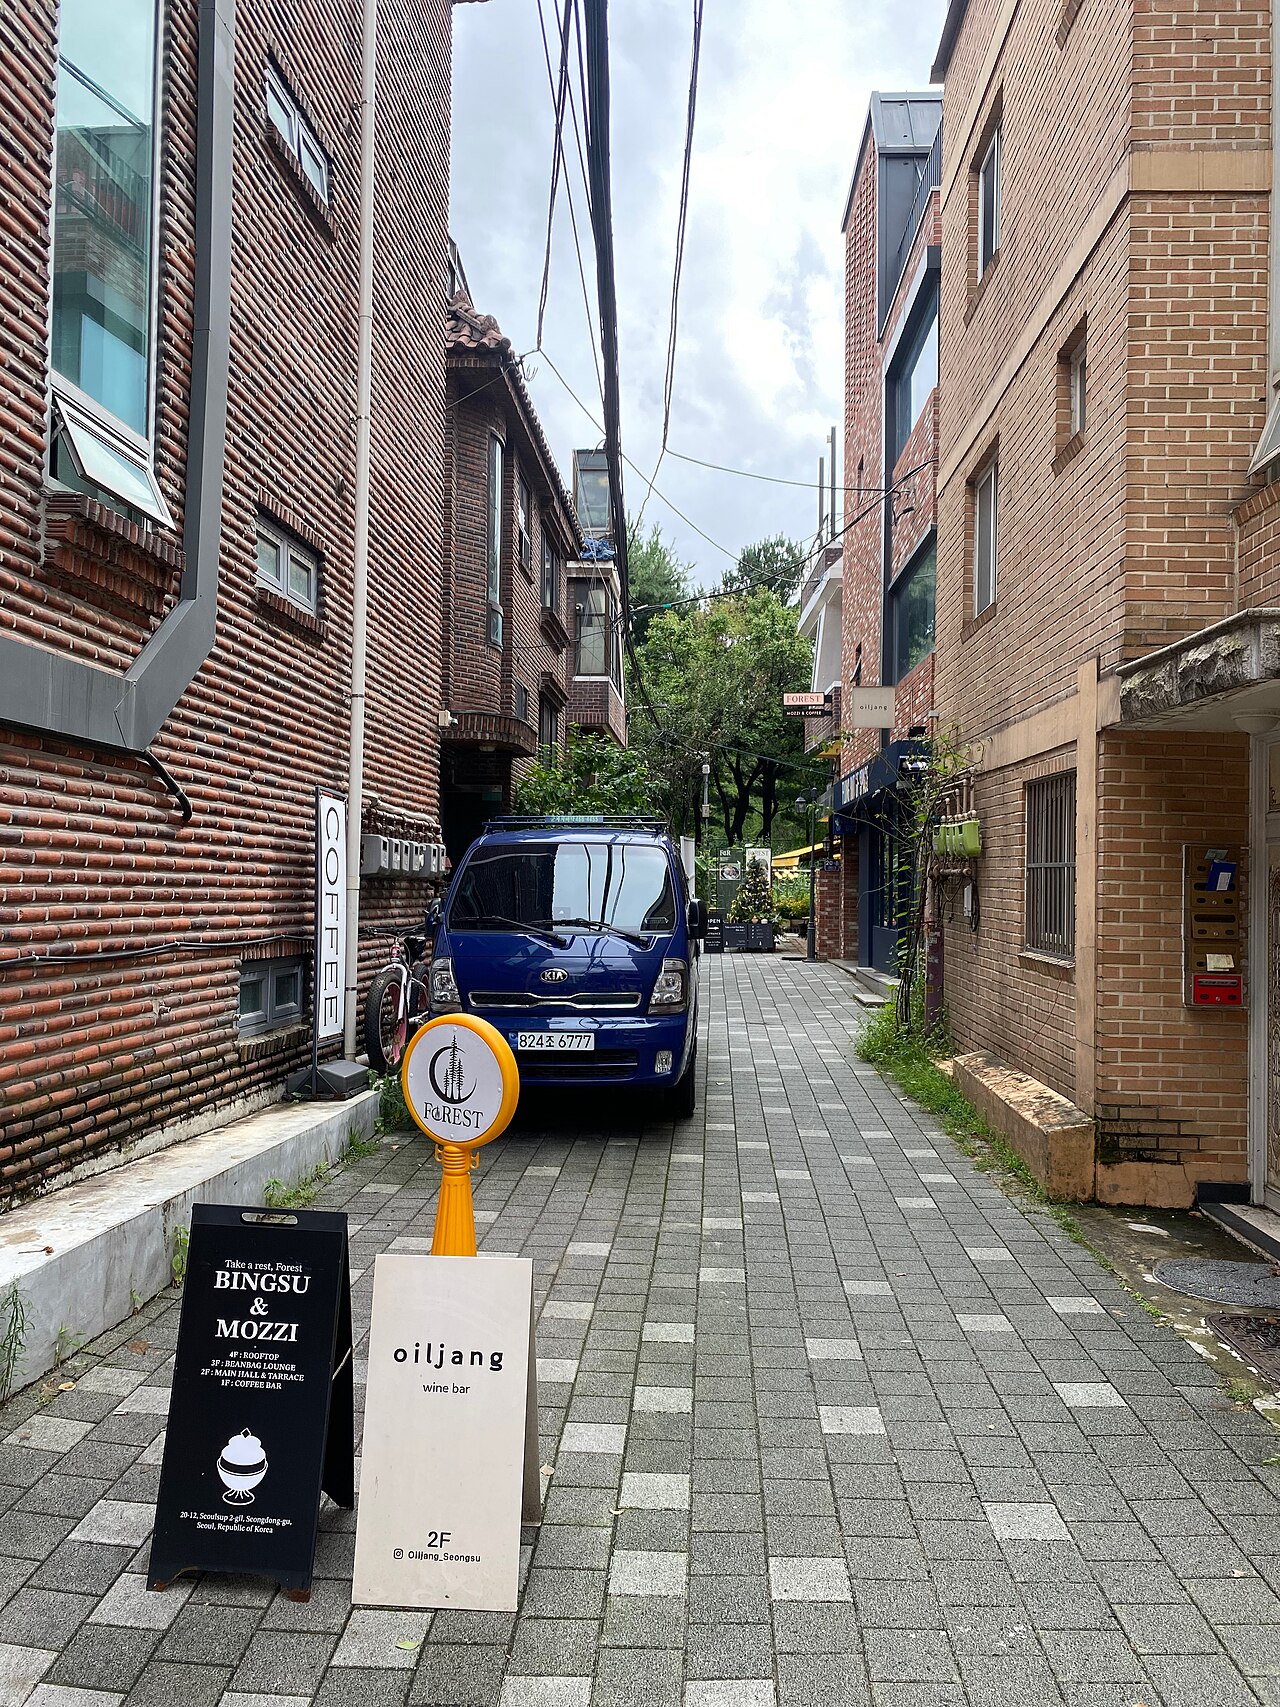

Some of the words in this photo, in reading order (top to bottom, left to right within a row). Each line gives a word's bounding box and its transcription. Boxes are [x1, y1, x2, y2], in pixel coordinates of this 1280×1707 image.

[786, 694, 821, 703] FOREST
[859, 703, 888, 711] oiljang
[324, 806, 340, 1027] COFFEE
[544, 971, 564, 981] KIA
[558, 1034, 592, 1049] 6777
[423, 1101, 484, 1129] FOREST
[225, 1259, 246, 1269] Take
[247, 1261, 253, 1270] a
[254, 1261, 274, 1272] rest,
[275, 1262, 303, 1272] Forest
[213, 1270, 312, 1294] BINGSU
[249, 1296, 269, 1316] &
[214, 1318, 300, 1342] MOZZI
[243, 1351, 280, 1361] ROOFTOP
[393, 1342, 504, 1372] oiljang
[225, 1360, 262, 1370] BEANBAG
[263, 1362, 296, 1372] LOUNGE
[214, 1369, 237, 1378] MAIN
[237, 1370, 260, 1379] HALL
[268, 1372, 305, 1382] TARRACE
[234, 1380, 265, 1389] COFFEE
[265, 1382, 282, 1390] BAR
[422, 1381, 450, 1394] wine
[452, 1382, 471, 1394] bar
[196, 1521, 216, 1531] Seoul,
[217, 1522, 245, 1533] Republic
[254, 1526, 274, 1534] Korea
[427, 1531, 452, 1549] 2F
